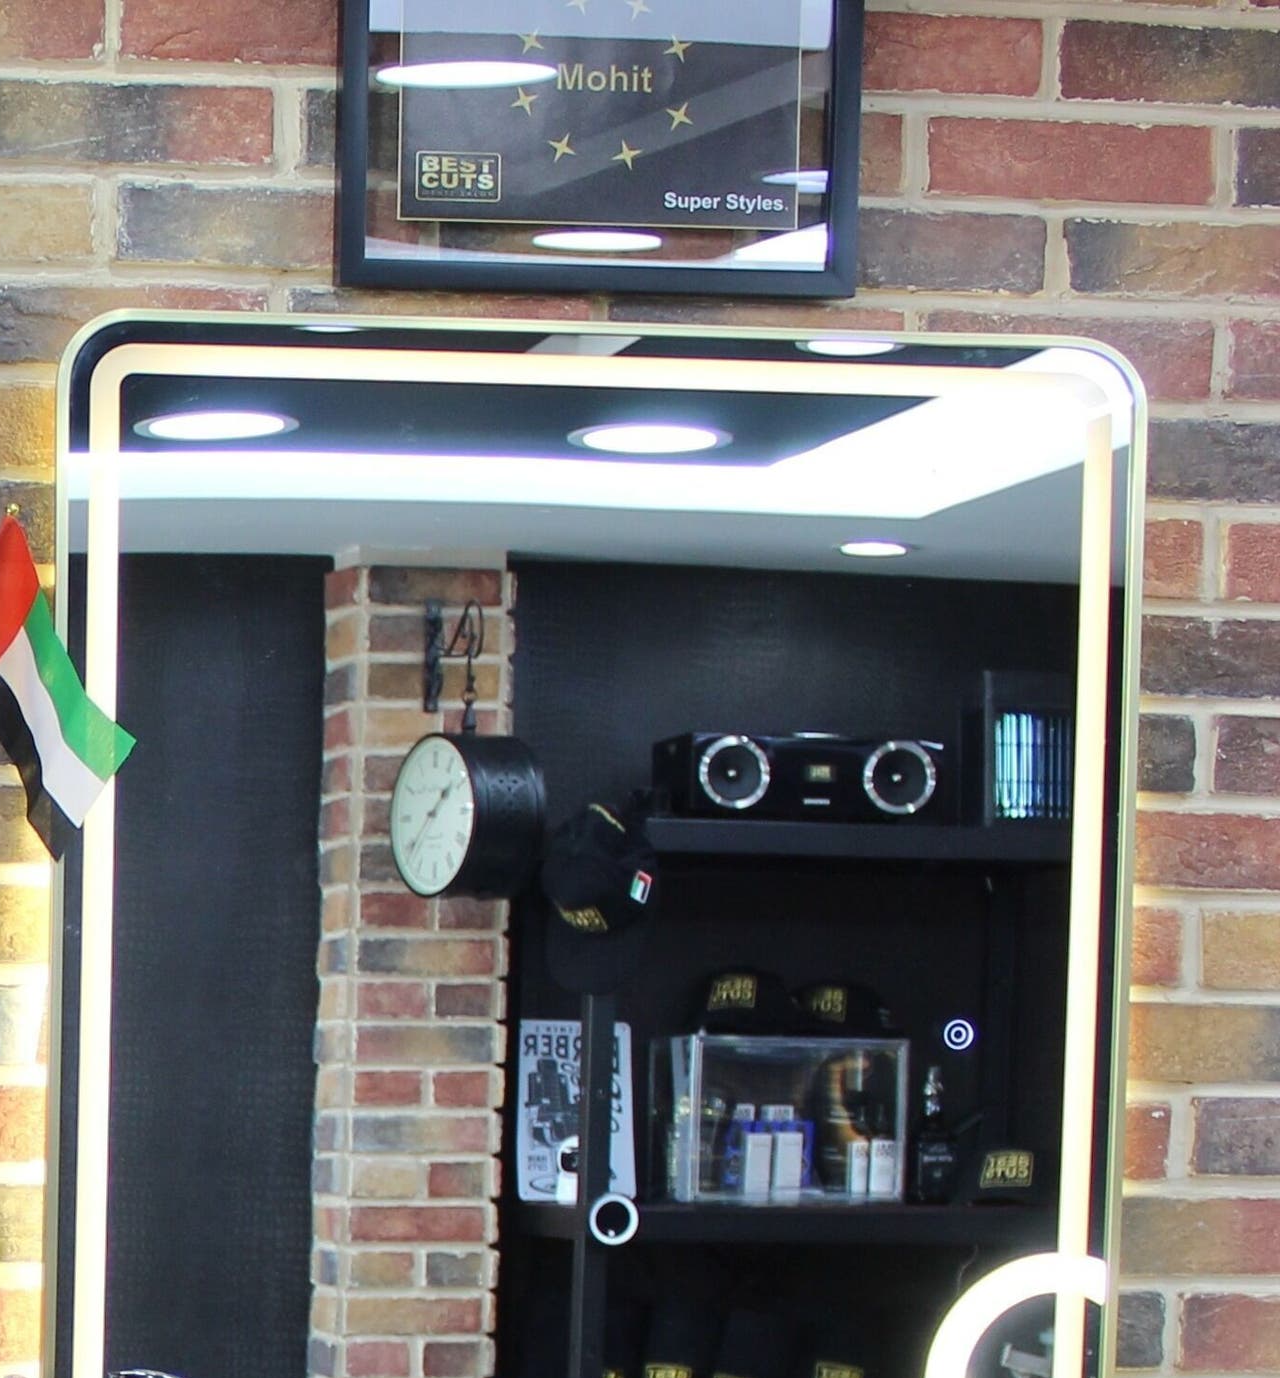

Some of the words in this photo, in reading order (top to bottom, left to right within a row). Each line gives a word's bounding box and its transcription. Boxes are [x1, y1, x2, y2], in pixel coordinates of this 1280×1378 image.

[556, 63, 653, 94] Mohit
[422, 156, 494, 173] BEST
[421, 173, 494, 190] CUTS
[664, 191, 722, 212] Super
[725, 193, 789, 212] Styles.
